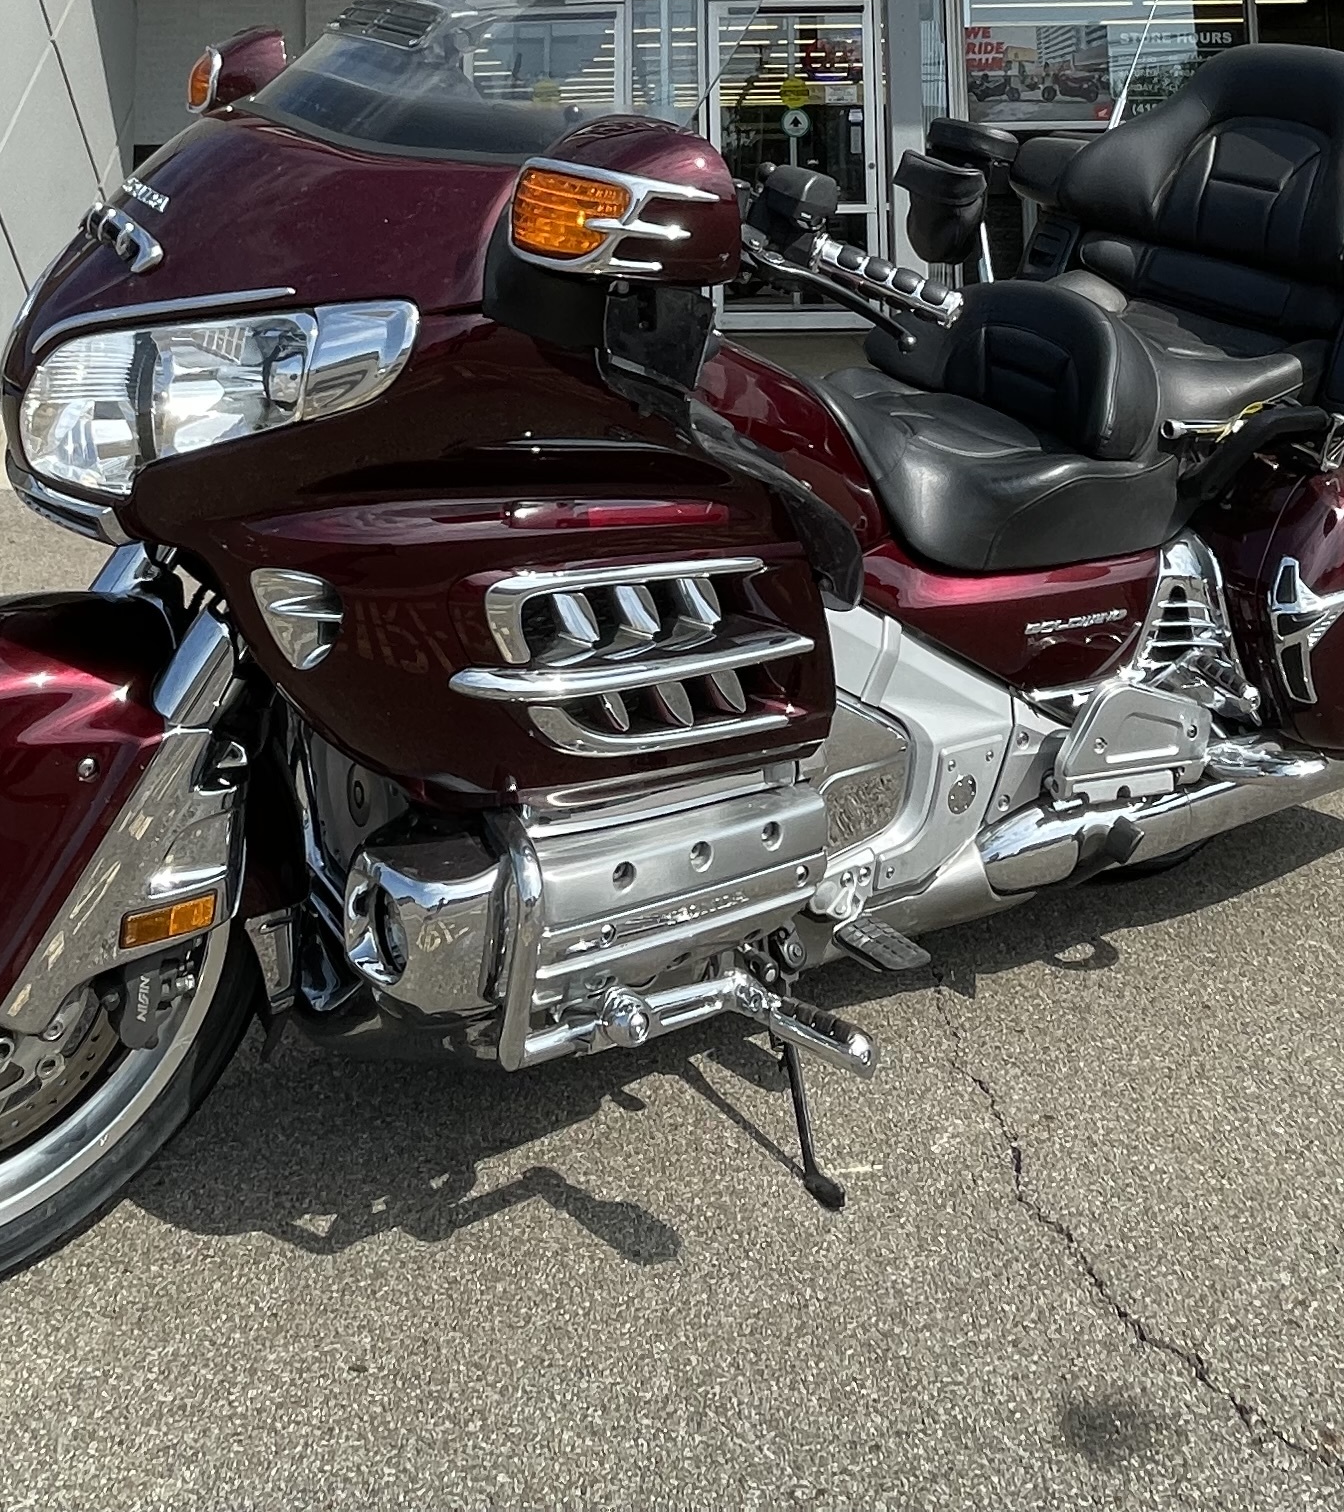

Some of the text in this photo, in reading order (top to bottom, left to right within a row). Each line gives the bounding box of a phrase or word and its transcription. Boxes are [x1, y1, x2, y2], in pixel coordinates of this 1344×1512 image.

[1119, 32, 1233, 44] STORE HOURS
[966, 41, 1005, 55] RIDE
